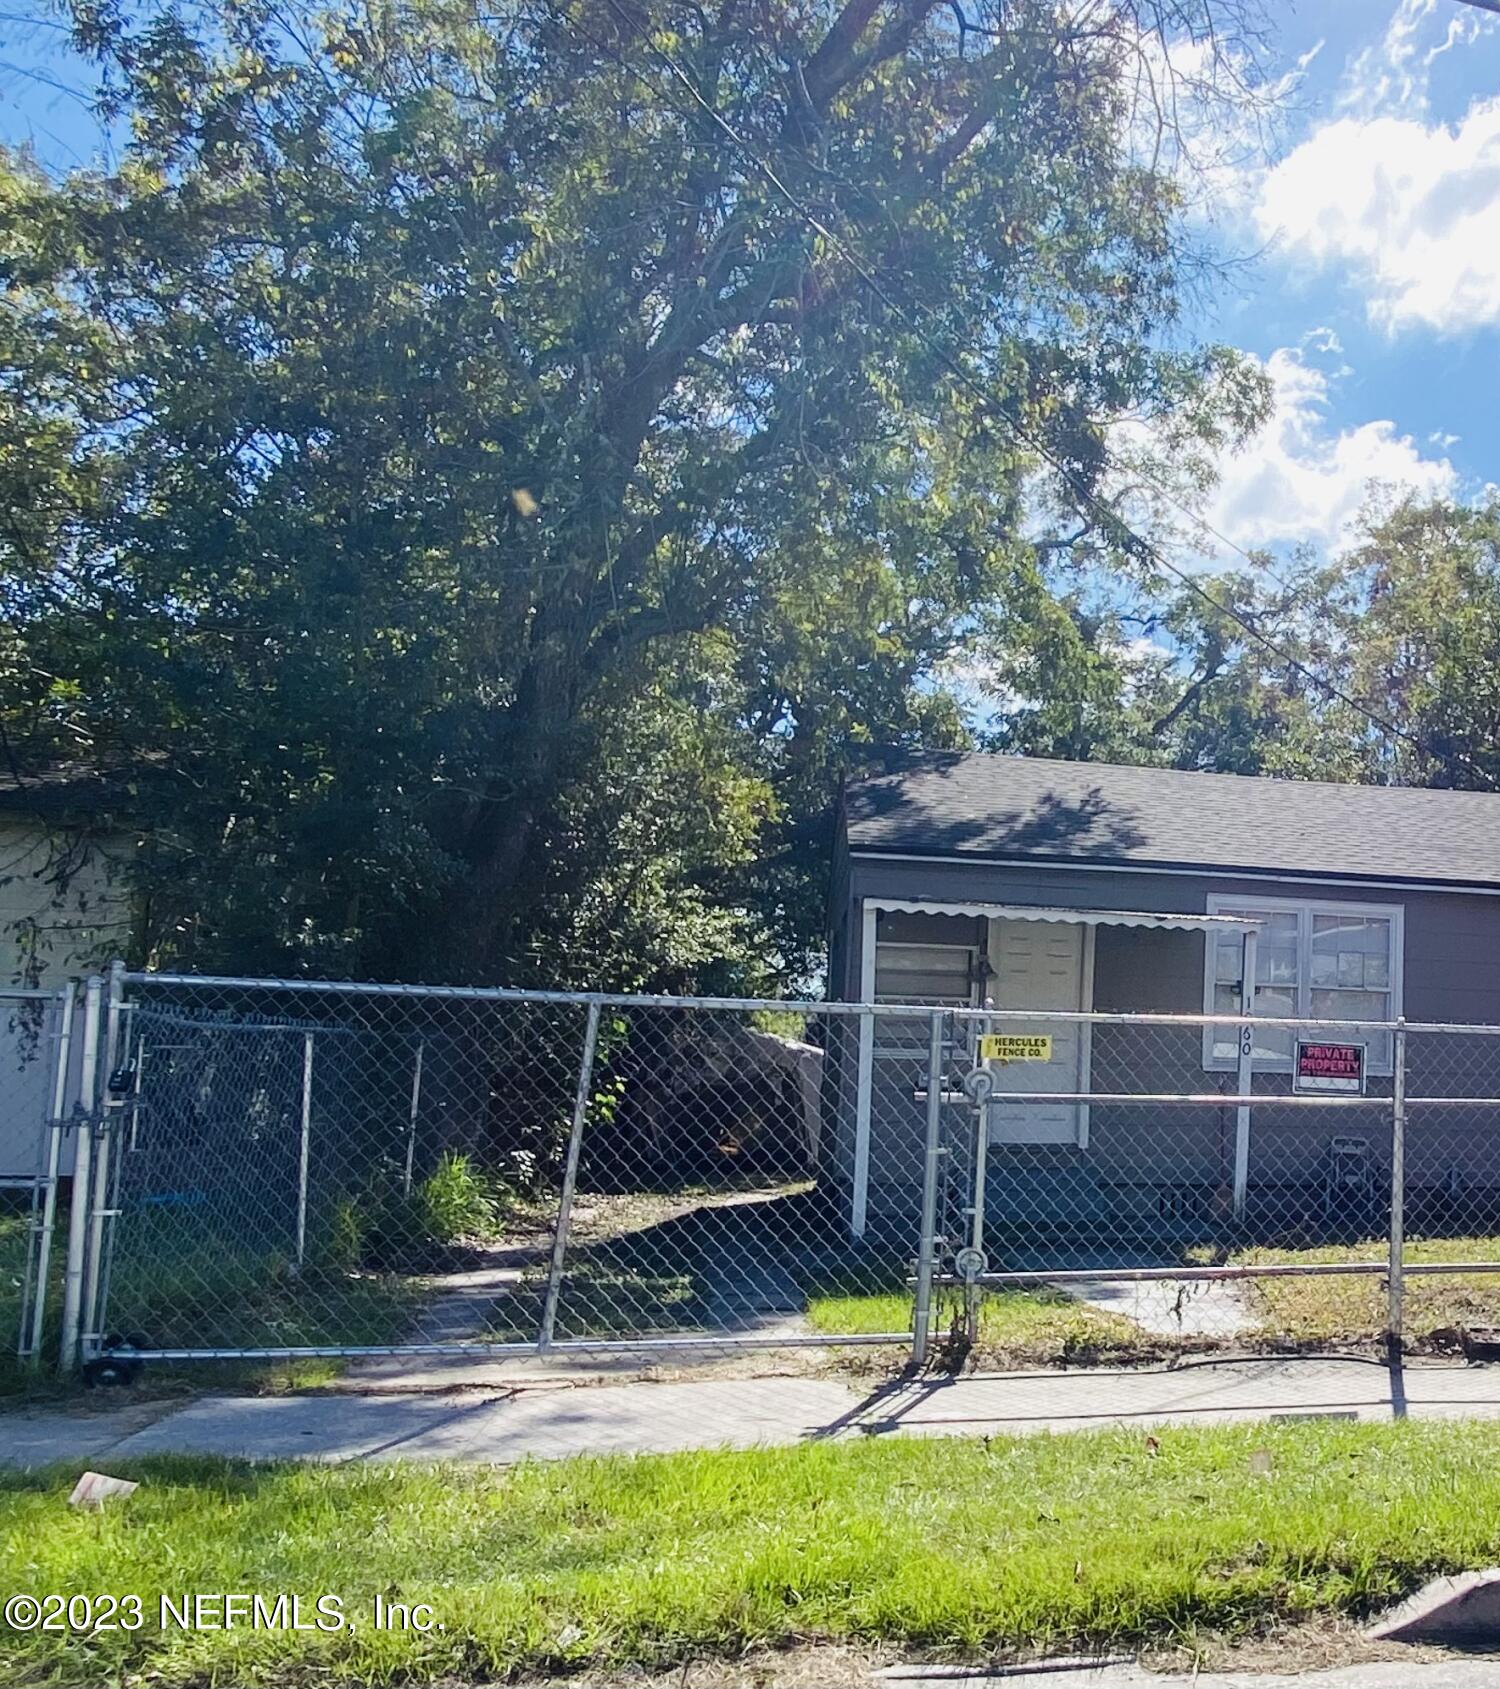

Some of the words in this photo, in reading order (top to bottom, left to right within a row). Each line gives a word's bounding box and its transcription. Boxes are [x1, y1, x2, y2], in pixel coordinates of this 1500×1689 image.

[995, 1038, 1047, 1047] HERCULES
[998, 1048, 1026, 1056] FENCE
[1028, 1048, 1043, 1056] CO.
[1307, 1047, 1355, 1060] PRIVATE
[1301, 1058, 1360, 1071] PROPERTY
